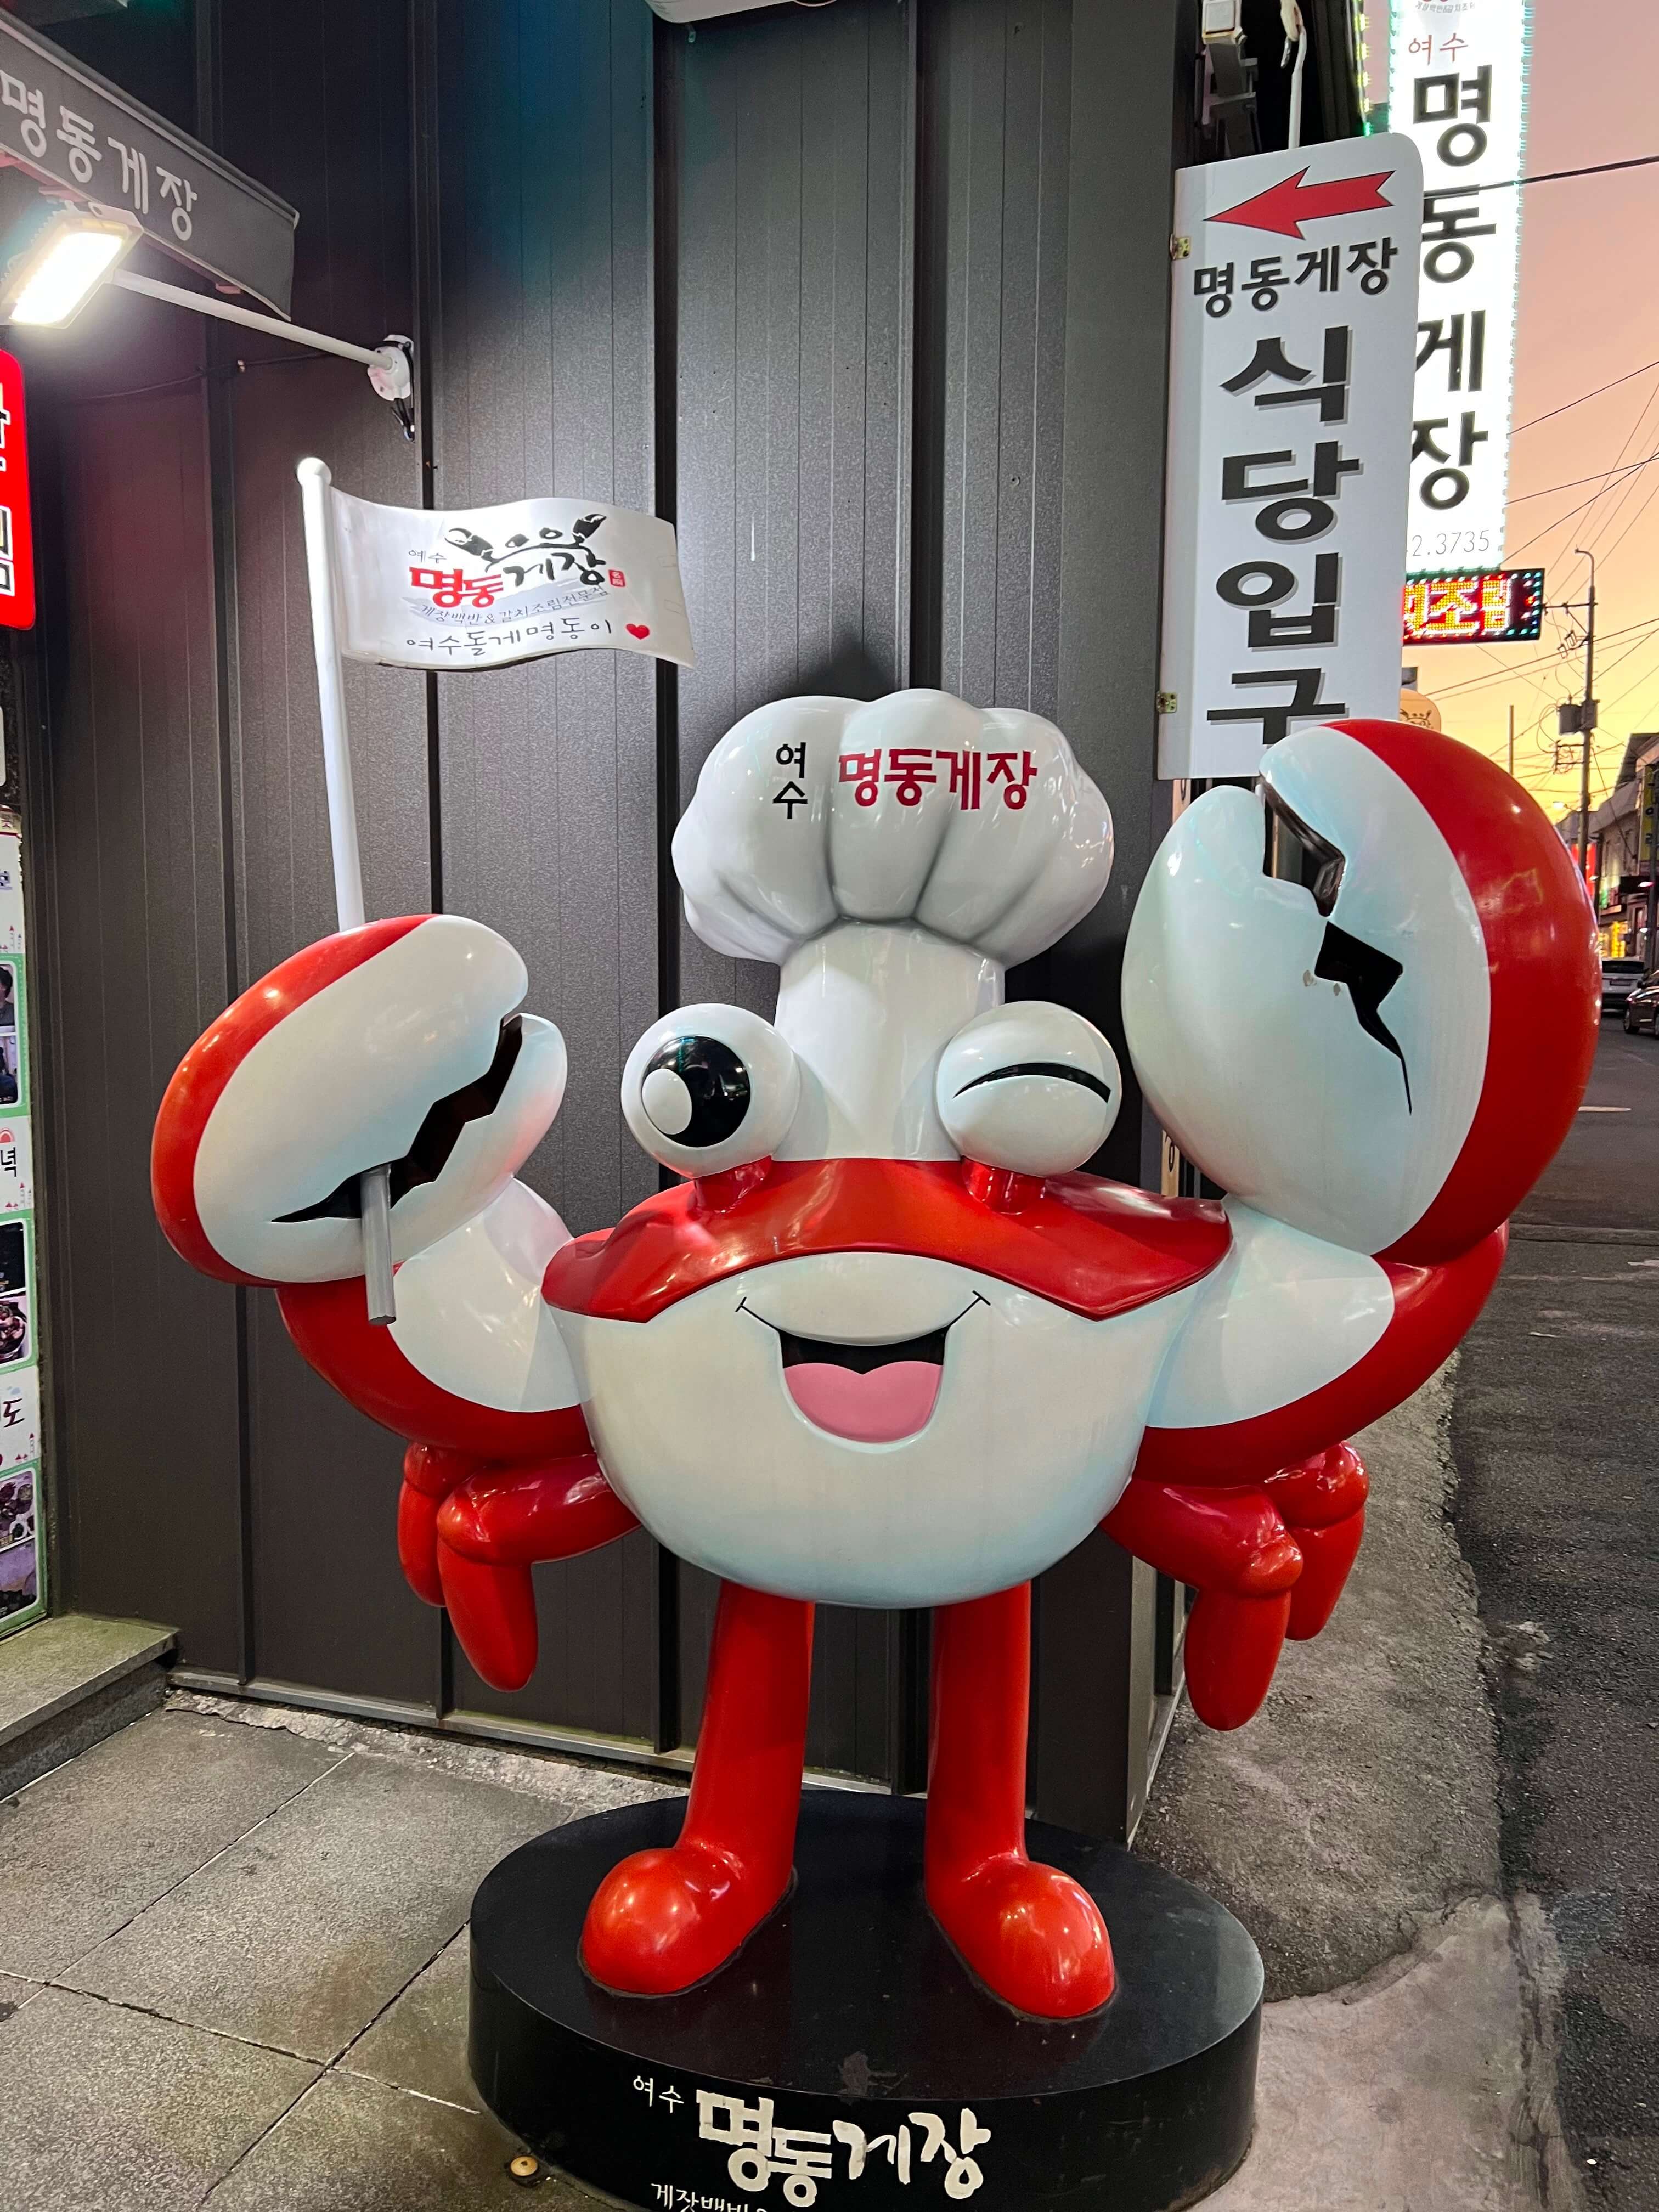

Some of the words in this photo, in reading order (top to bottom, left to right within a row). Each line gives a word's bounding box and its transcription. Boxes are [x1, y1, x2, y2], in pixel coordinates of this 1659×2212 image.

[1408, 33, 1469, 65] 여수
[1, 69, 198, 241] 명동게장
[1194, 237, 1398, 318] 명동게장
[1407, 530, 1490, 556] 2.3735
[772, 742, 808, 820] 여수
[838, 749, 1038, 810] 명동게장
[633, 2075, 684, 2113] 여수
[696, 2089, 991, 2208] 명동게장
